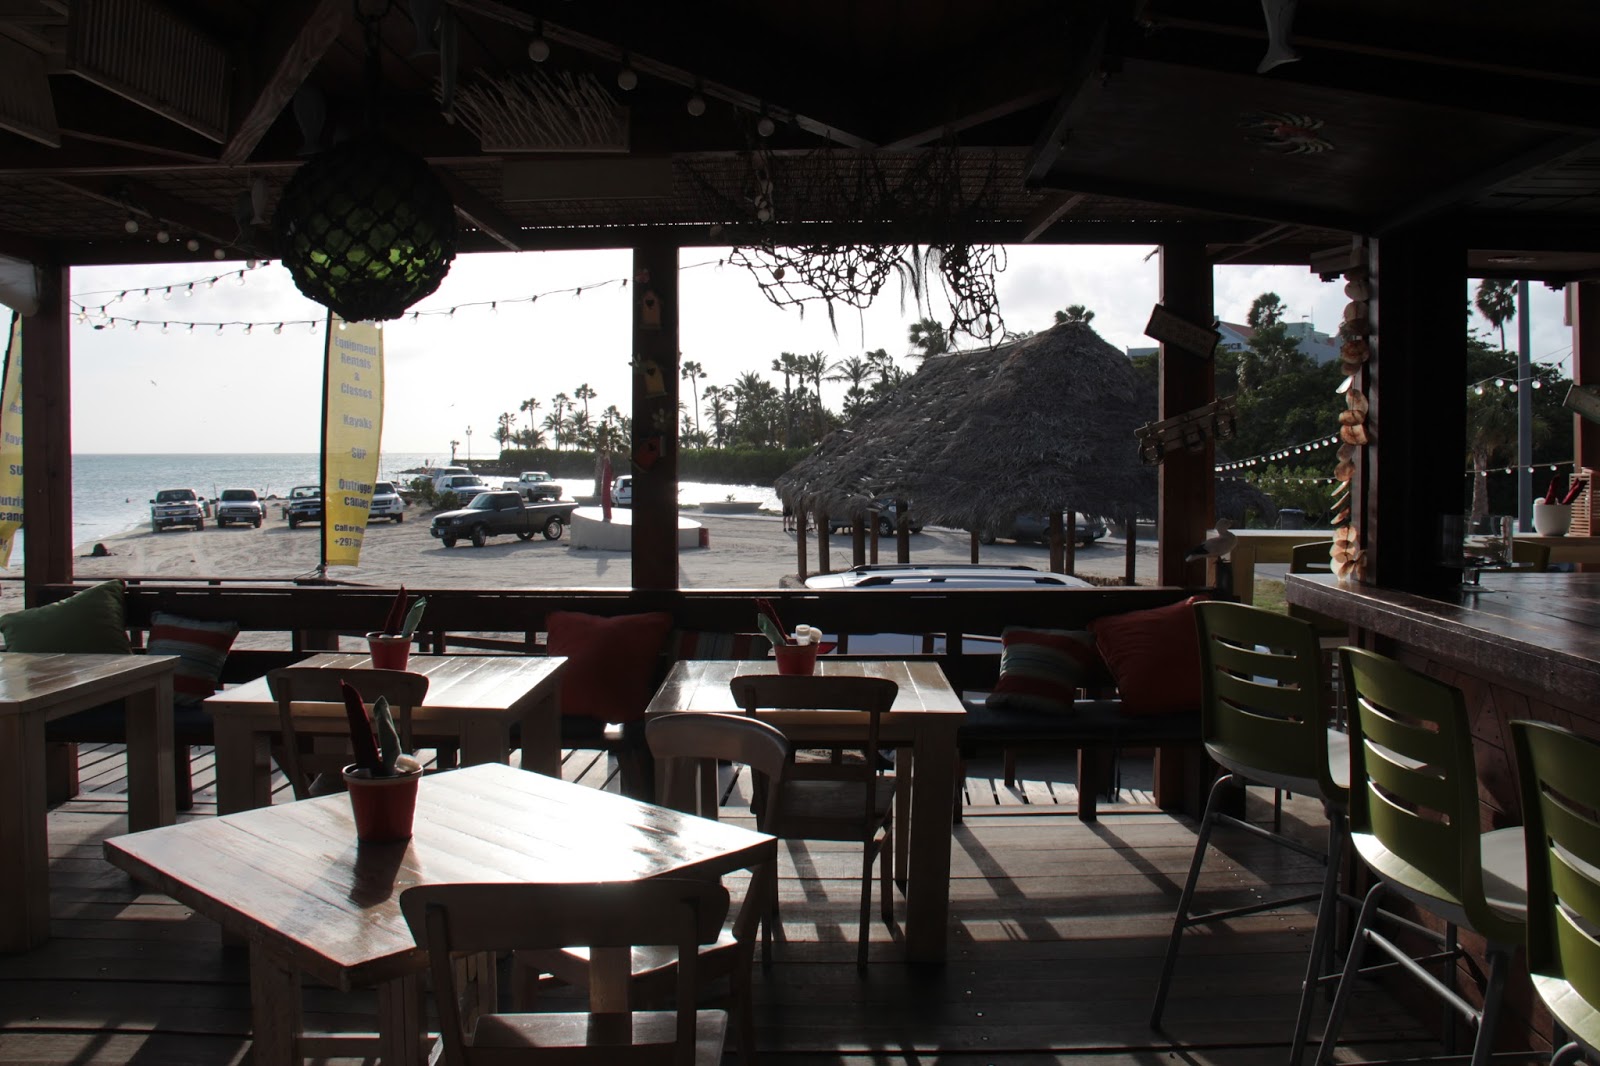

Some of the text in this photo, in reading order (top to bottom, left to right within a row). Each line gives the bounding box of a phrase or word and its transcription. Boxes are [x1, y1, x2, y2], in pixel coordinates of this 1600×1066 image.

[335, 336, 376, 356] Equipment
[341, 352, 372, 369] Rentals
[341, 382, 372, 399] Classes
[343, 414, 372, 429] Kayaks
[351, 447, 367, 460] SUP
[9, 464, 24, 475] SU
[339, 479, 373, 494] Outrigger
